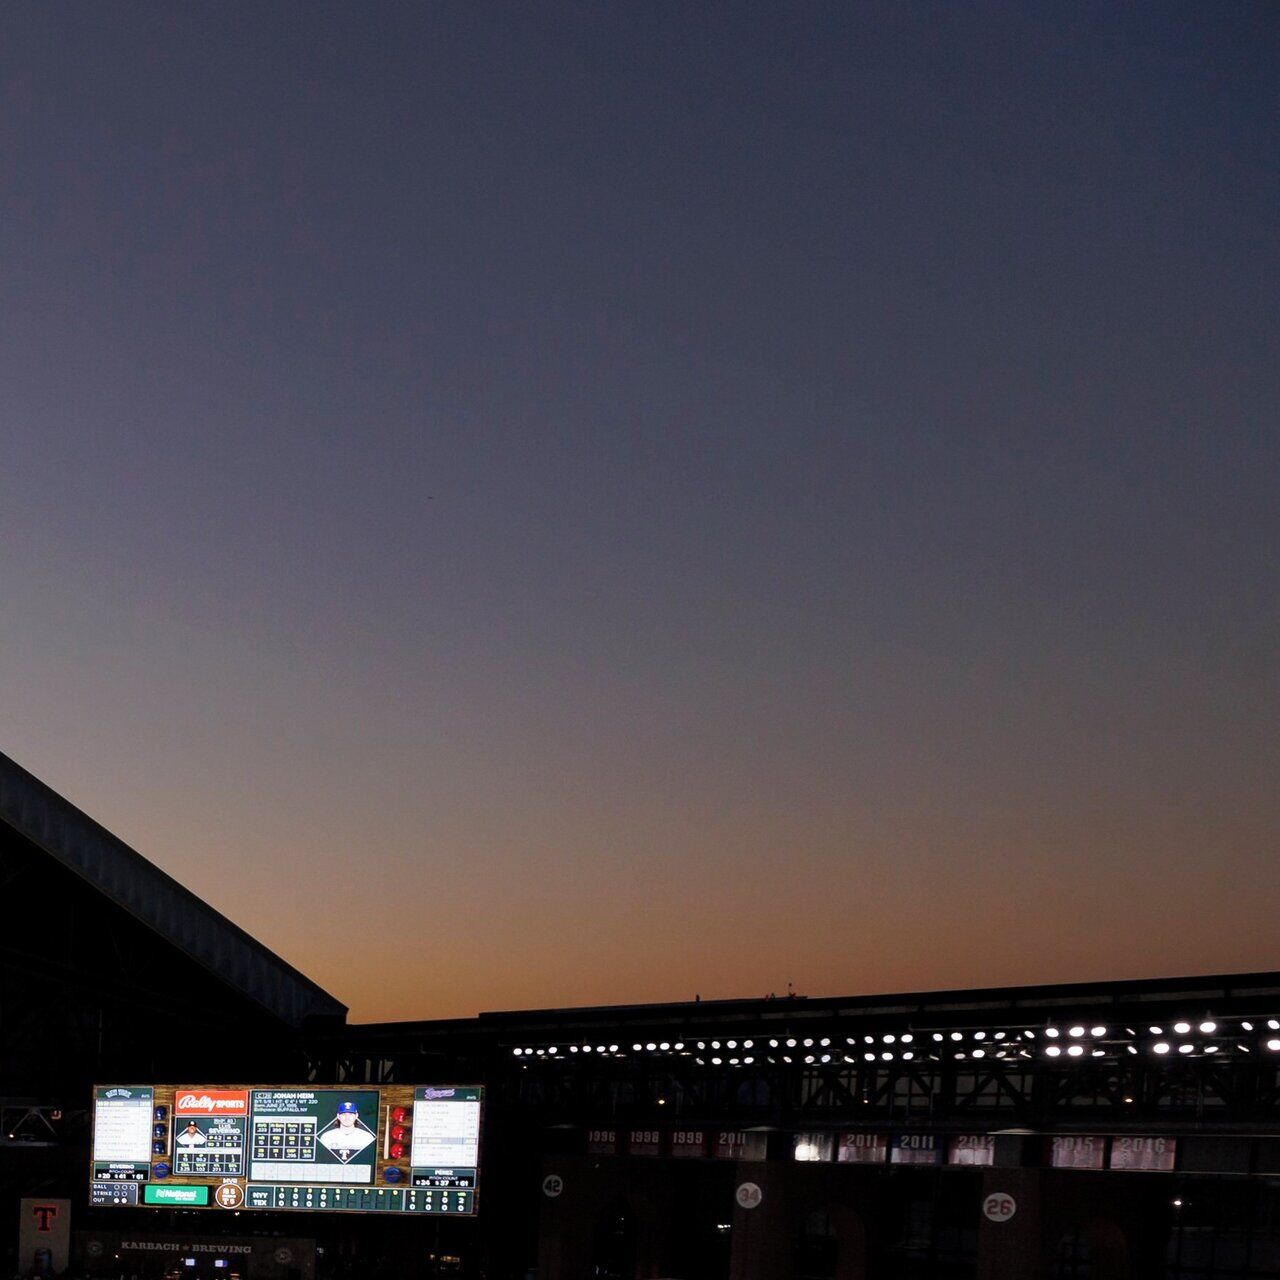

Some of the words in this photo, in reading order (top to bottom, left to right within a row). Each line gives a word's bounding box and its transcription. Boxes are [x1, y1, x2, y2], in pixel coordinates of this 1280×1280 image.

[178, 1095, 216, 1112] Bally
[216, 1100, 244, 1108] SPORTS
[589, 1131, 616, 1142] 1996
[631, 1131, 660, 1143] 1998
[673, 1132, 703, 1144] 1999
[846, 1134, 878, 1147] 2011
[900, 1136, 934, 1149] 2011
[959, 1136, 995, 1149] 2012
[1053, 1137, 1094, 1150] 2015
[1122, 1138, 1165, 1153] 2016
[545, 1180, 560, 1192] 42
[164, 1189, 197, 1198] National
[741, 1188, 759, 1201] 34
[986, 1201, 1012, 1214] 26
[34, 1204, 59, 1231] T
[122, 1241, 180, 1251] KARBACH
[192, 1245, 251, 1254] BREWING
